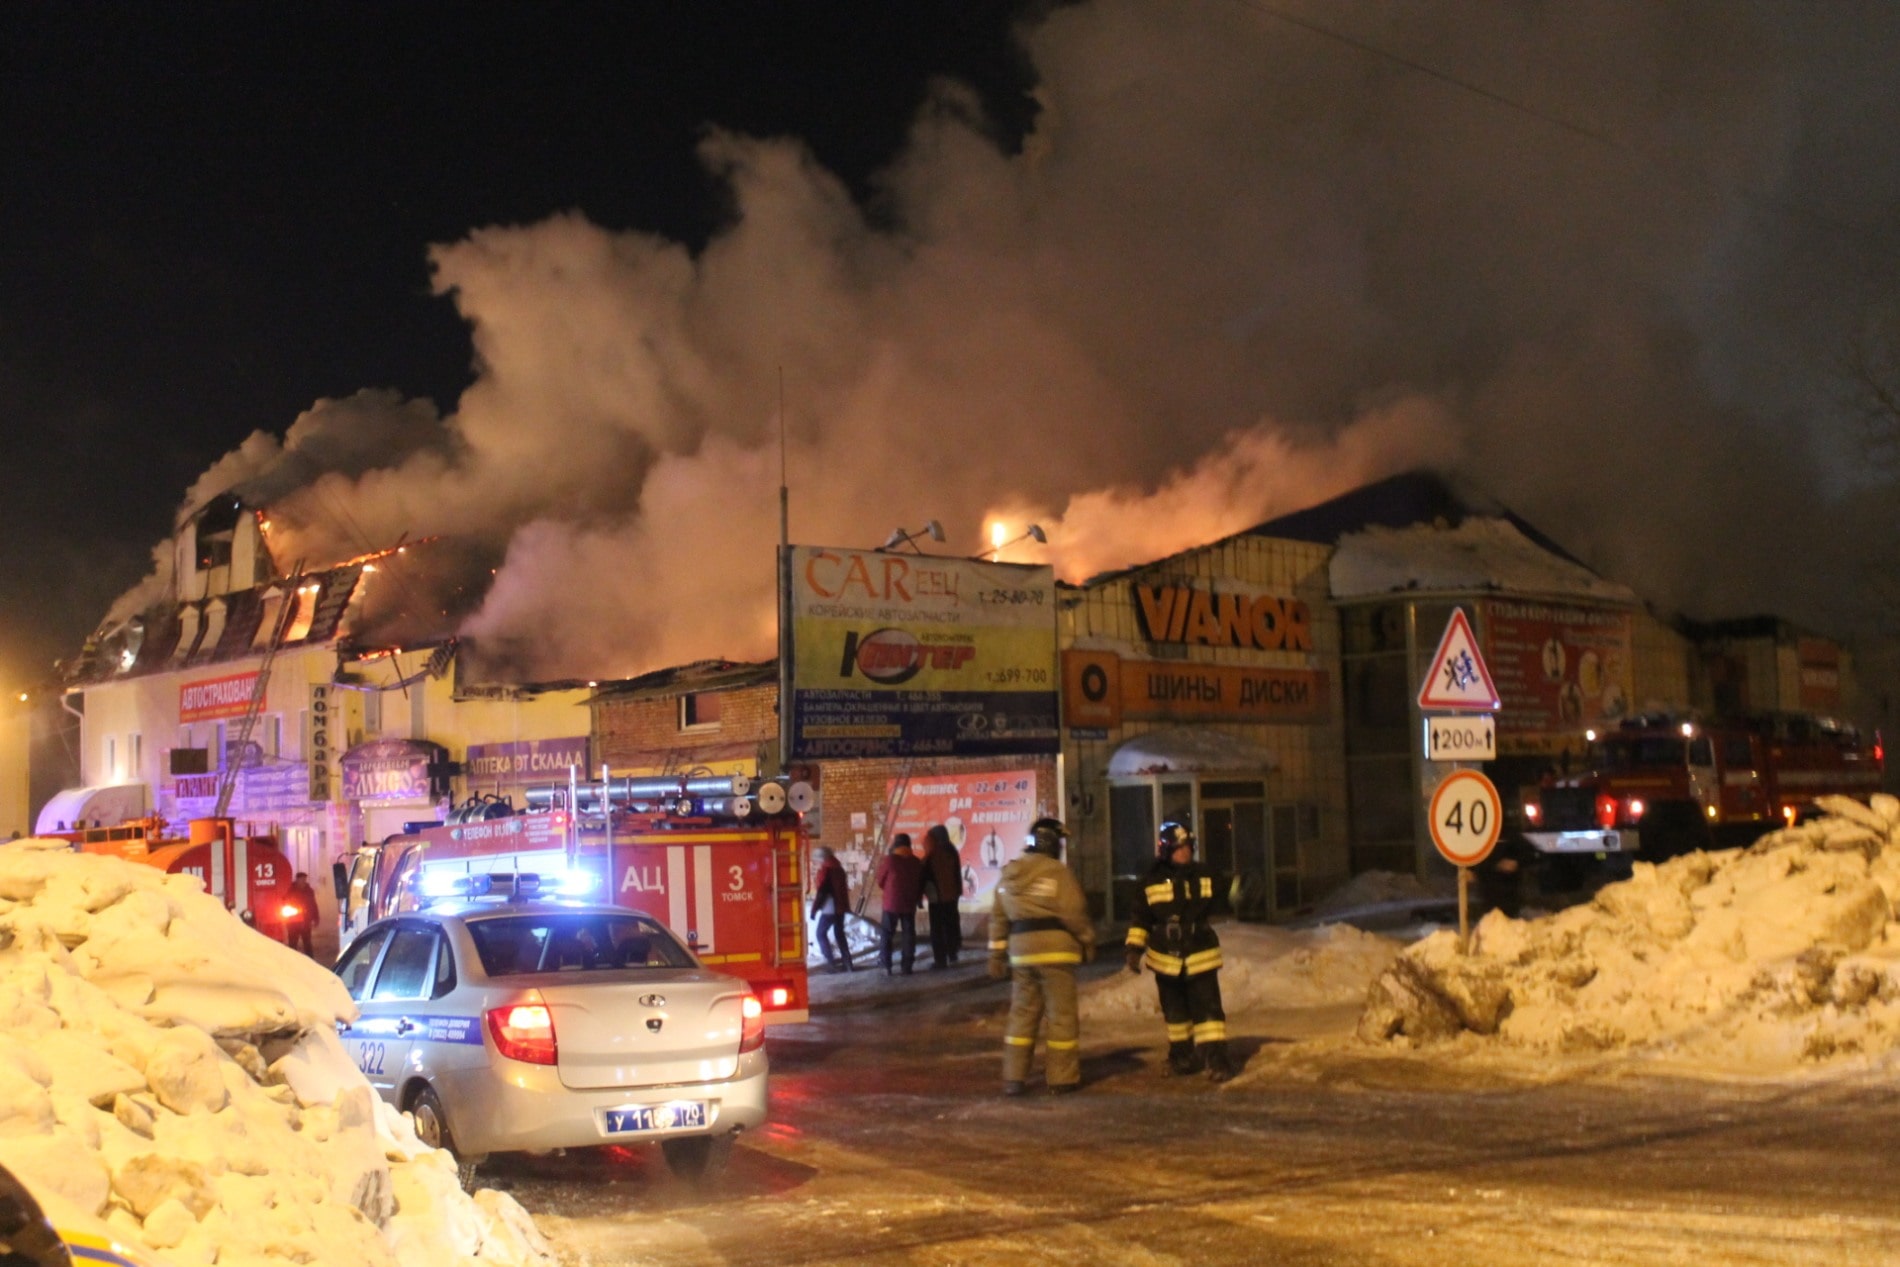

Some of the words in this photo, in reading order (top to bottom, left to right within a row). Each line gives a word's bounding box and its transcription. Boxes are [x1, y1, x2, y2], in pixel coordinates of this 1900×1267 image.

[1137, 584, 1312, 652] VIANOR
[181, 677, 268, 712] АВТОСТРАХОВАН
[1147, 672, 1221, 702] ШИНЫ
[1239, 676, 1309, 707] ДИСКИ
[469, 756, 511, 775] АПТЕКА
[514, 754, 529, 772] ОТ
[531, 750, 583, 771] СКЛАДА
[1445, 799, 1487, 836] 40
[255, 863, 274, 877] 13
[620, 865, 665, 895] АЦ
[728, 865, 745, 892] 3
[721, 891, 754, 902] ТОМСК
[359, 1041, 386, 1075] 322
